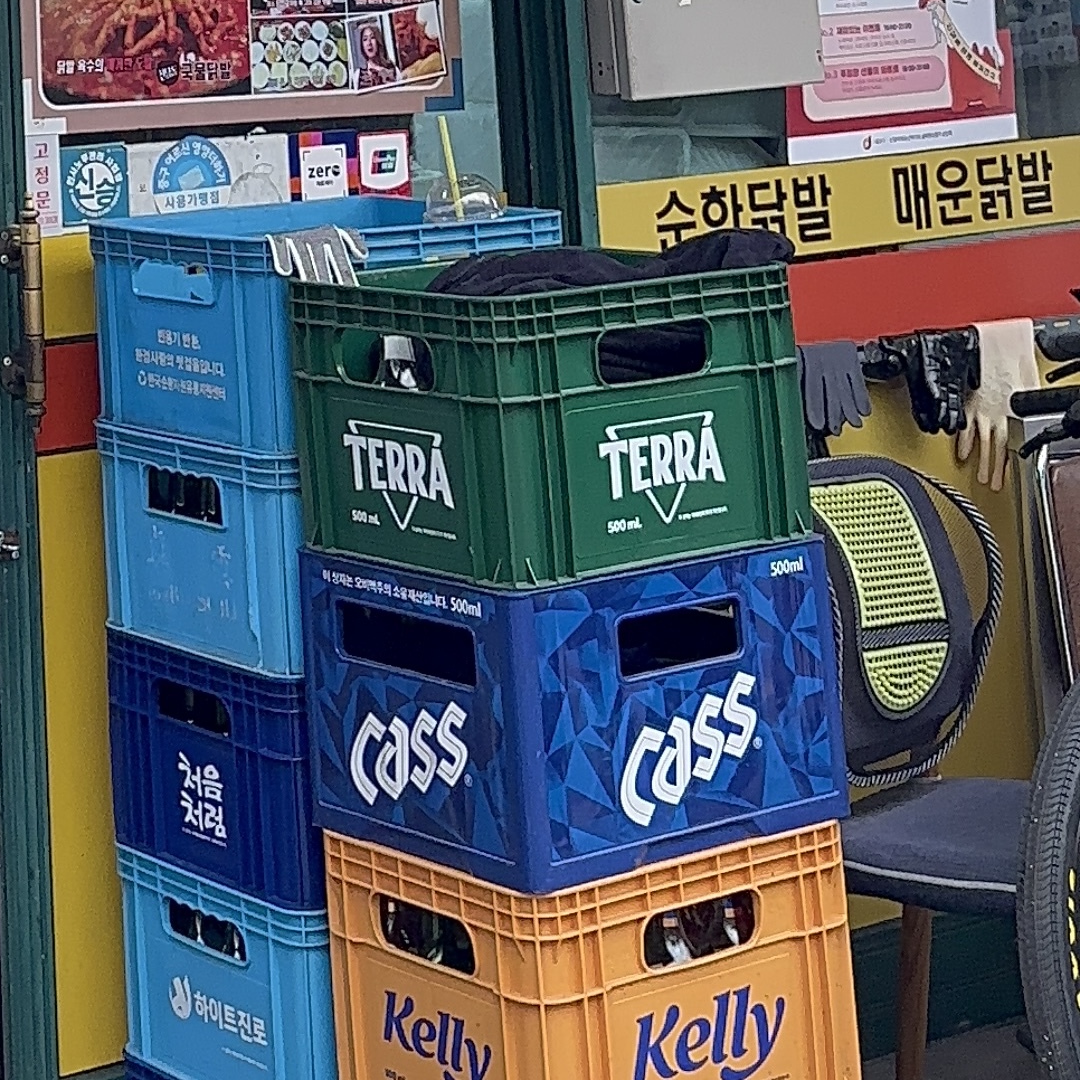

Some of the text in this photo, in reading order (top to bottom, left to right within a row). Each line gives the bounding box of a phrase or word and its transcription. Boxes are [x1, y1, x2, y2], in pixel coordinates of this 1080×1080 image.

[164, 190, 220, 209] 사용가맹점
[308, 165, 341, 179] zero
[892, 150, 1053, 230] 매운닭발
[343, 432, 456, 510] TERRA
[598, 425, 727, 501] TERRA
[770, 555, 804, 578] 500ml
[450, 595, 483, 619] 500ml
[178, 750, 224, 803] 처음
[180, 789, 228, 839] 처럼
[193, 989, 269, 1047] 하이트진로
[383, 989, 493, 1080] Kelly
[635, 984, 787, 1080] Kelly
